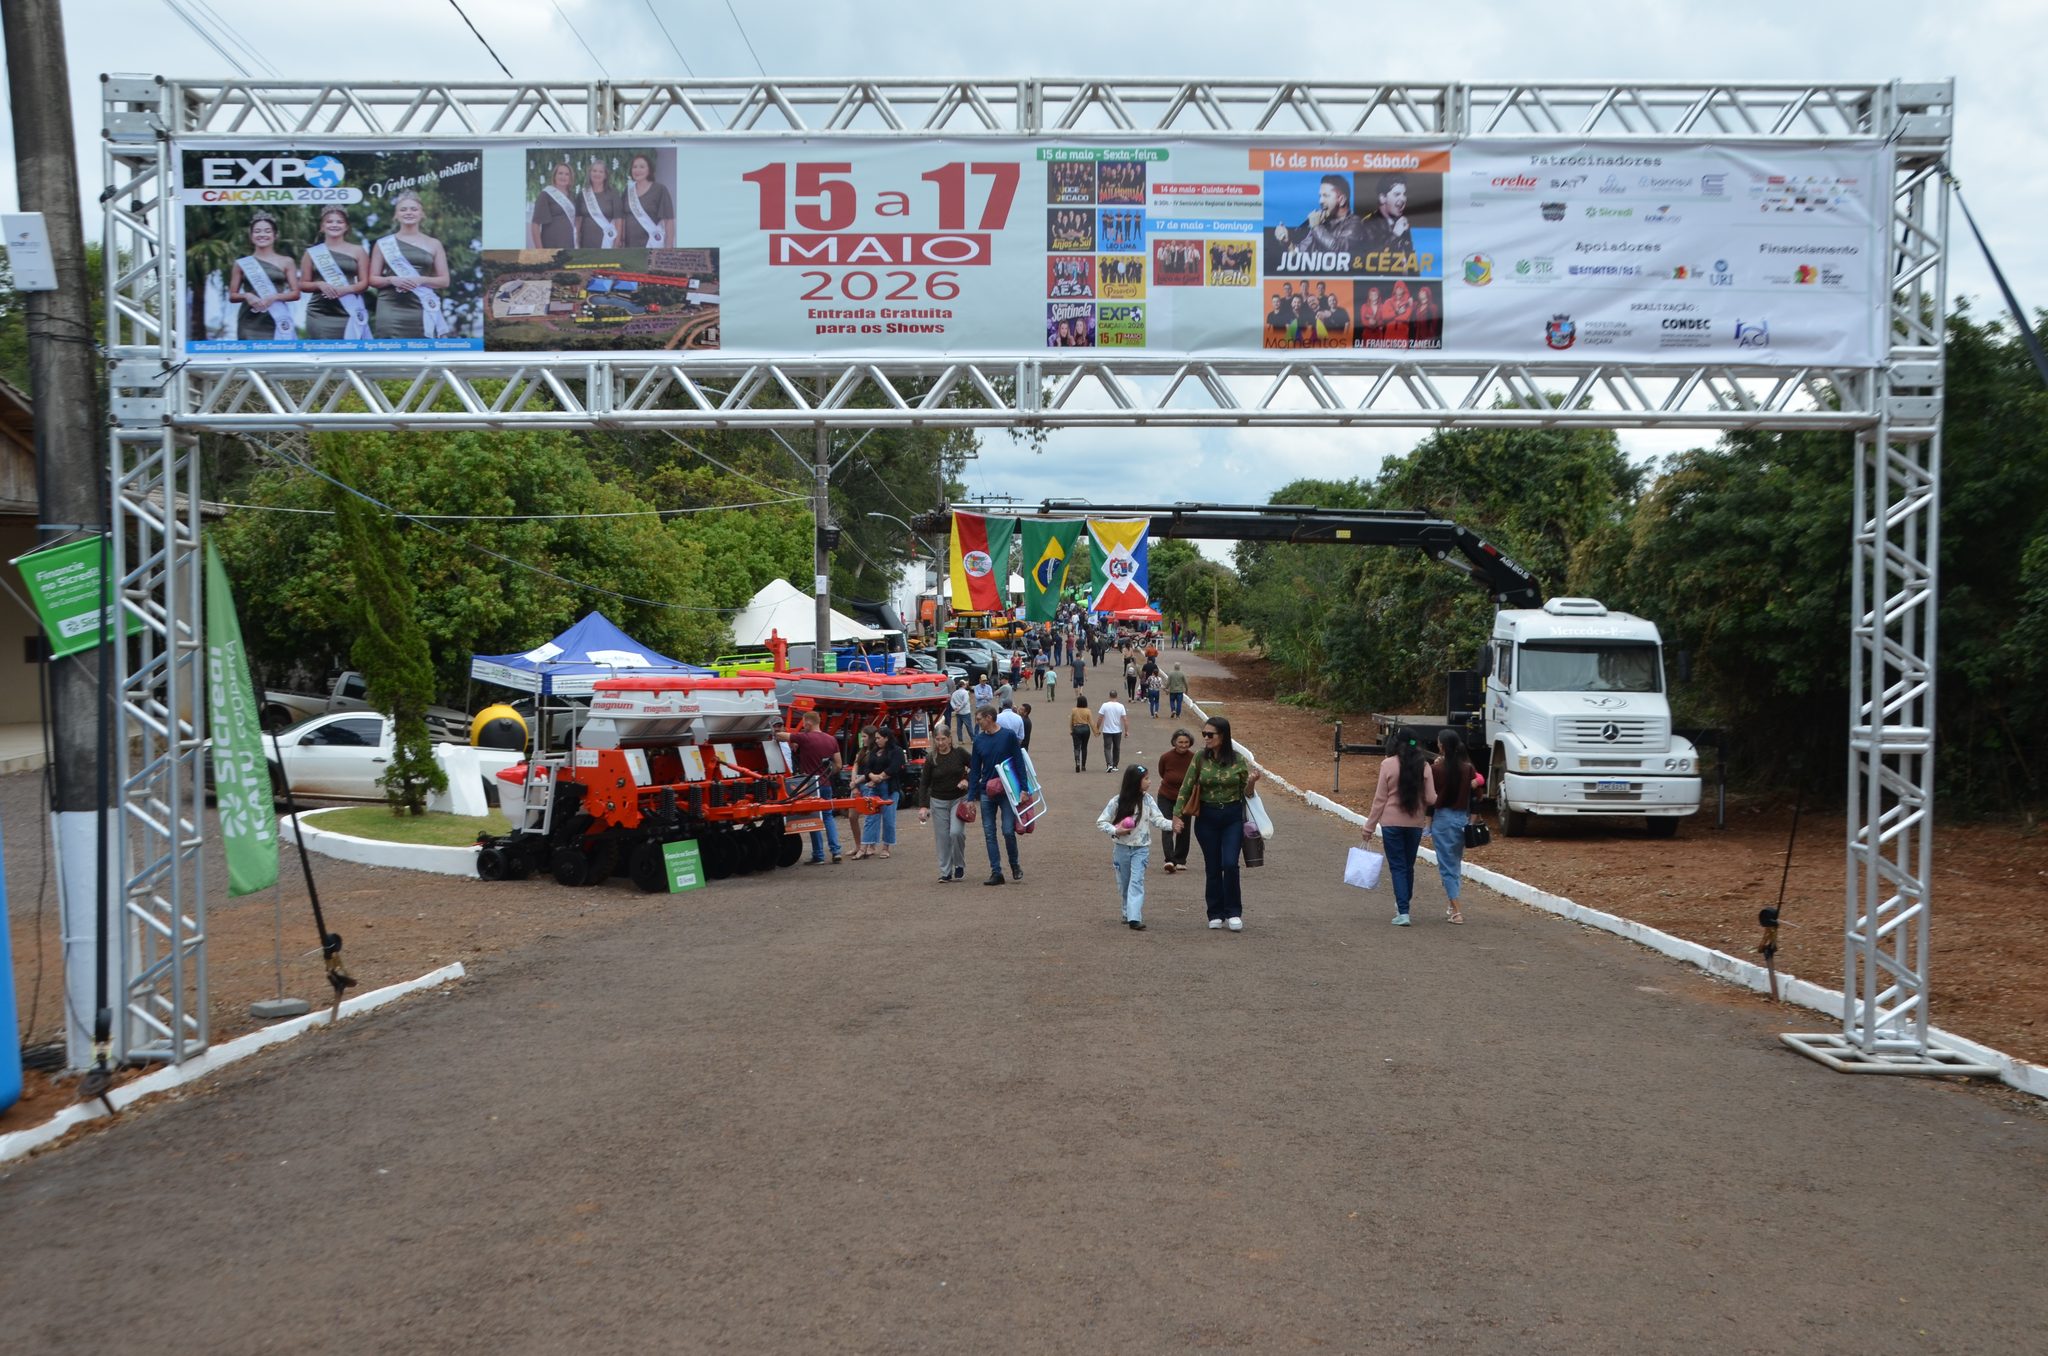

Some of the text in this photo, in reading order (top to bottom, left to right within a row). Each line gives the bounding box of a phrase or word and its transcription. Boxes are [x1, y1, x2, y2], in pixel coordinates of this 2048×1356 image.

[1043, 149, 1053, 159] 15
[1055, 149, 1067, 159] de
[1069, 149, 1094, 159] maio
[1103, 148, 1158, 160] Sexta-feira
[1269, 153, 1284, 168] 16
[1289, 153, 1306, 168] de
[1310, 153, 1348, 168] maio
[1363, 153, 1420, 169] Sábado
[1530, 155, 1662, 167] Patrocinadores
[368, 157, 479, 198] Venha nos visitar!
[1491, 174, 1539, 187] creluz
[1178, 185, 1196, 193] maio
[1201, 185, 1243, 194] Quinta-feira
[202, 189, 349, 204] CAIÇARA 2026
[742, 162, 1021, 231] 15 a 17
[1156, 221, 1166, 230] 17
[1167, 221, 1178, 230] de
[1180, 222, 1204, 230] maio
[1213, 222, 1254, 232] Domingo
[1080, 237, 1092, 247] Sul
[1575, 241, 1661, 253] Apoiadores
[780, 236, 980, 262] MAIO
[1759, 243, 1859, 255] Financiamento
[1353, 256, 1363, 269] &
[1365, 248, 1434, 272] CÉZAR
[1211, 270, 1250, 286] Hello
[800, 271, 960, 300] 2026
[1051, 285, 1092, 296] AESA
[808, 308, 952, 319] Entrada Gratuita
[1052, 302, 1092, 322] Sentinela
[816, 323, 945, 334] para os Shows
[1265, 338, 1346, 348] Momentos
[1354, 339, 1441, 348] DJ FRANCISCO ZANELLA
[35, 562, 85, 581] Financie
[40, 582, 56, 592] no
[593, 702, 634, 711] magnum
[211, 646, 237, 783] Sicredi
[240, 751, 271, 841] ICATU
